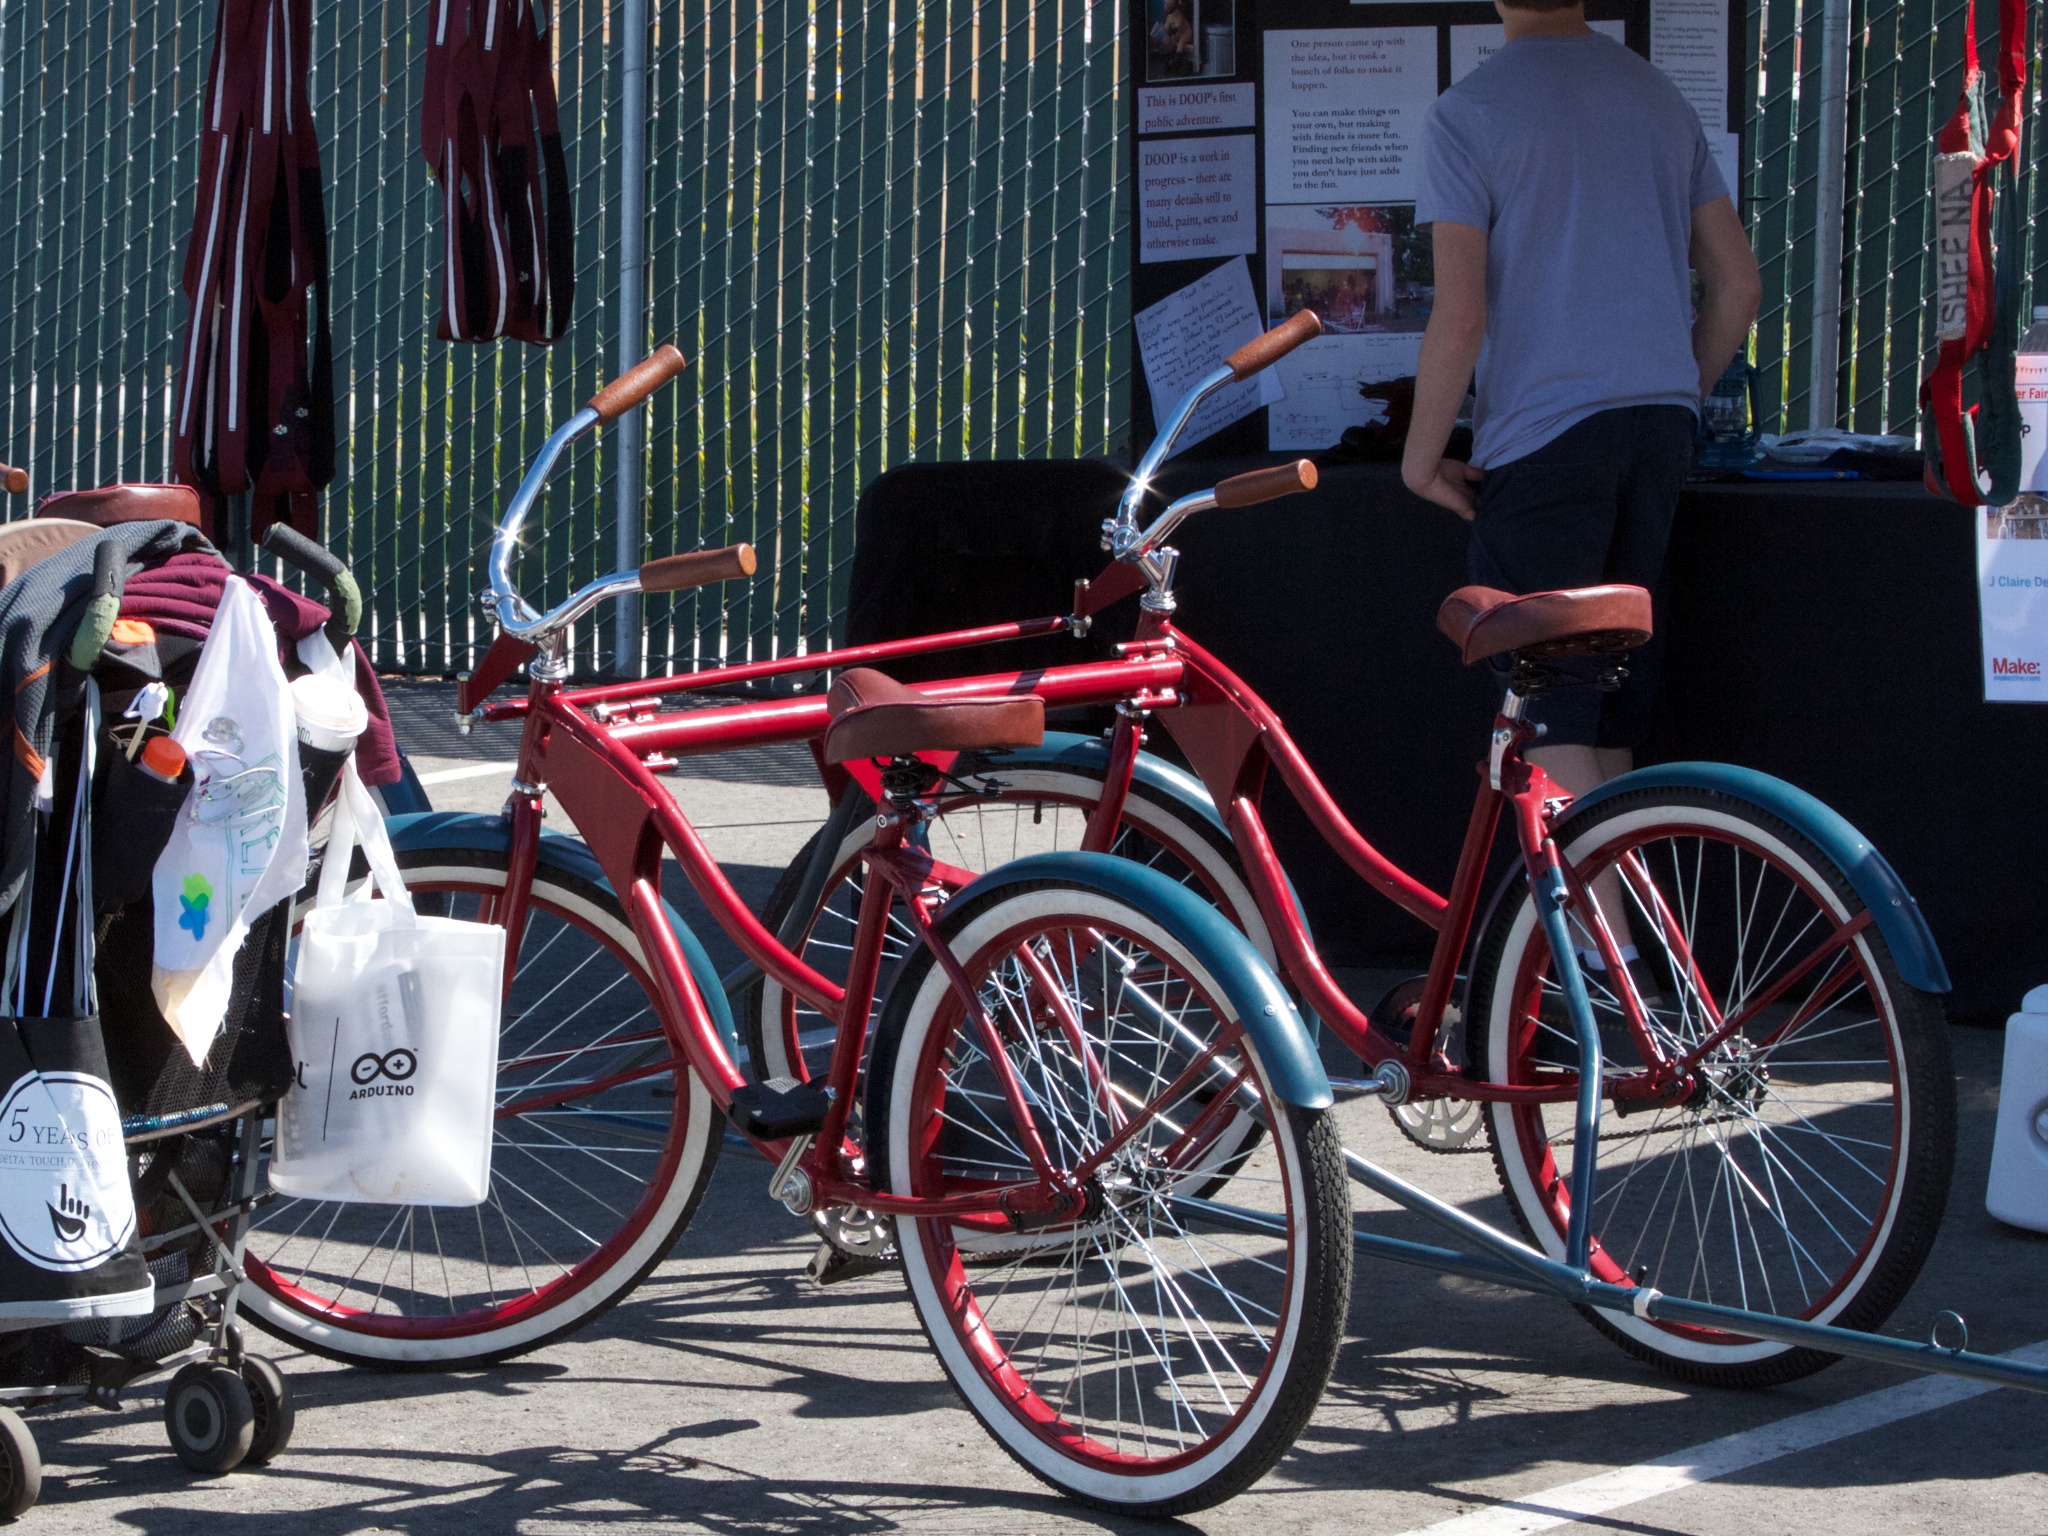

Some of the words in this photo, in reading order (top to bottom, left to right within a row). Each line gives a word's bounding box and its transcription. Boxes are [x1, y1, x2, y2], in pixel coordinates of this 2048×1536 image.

[1291, 40, 1310, 48] One
[1313, 41, 1343, 49] person
[1372, 40, 1384, 48] up
[1386, 37, 1405, 46] with
[1308, 54, 1330, 62] idea,
[1359, 52, 1378, 60] took
[1291, 67, 1319, 76] bunch
[1334, 66, 1355, 74] folks
[1292, 82, 1327, 91] happen.
[1145, 95, 1166, 107] This
[1169, 95, 1176, 105] is
[1179, 92, 1216, 105] DOOP's
[1219, 91, 1236, 103] first
[1292, 109, 1310, 117] You
[1332, 108, 1355, 116] make
[1359, 108, 1386, 117] things
[1145, 115, 1173, 132] public
[1176, 115, 1222, 126] adventure.
[1292, 122, 1312, 131] your
[1339, 120, 1353, 128] but
[1356, 120, 1390, 128] making
[1293, 133, 1311, 141] with
[1314, 132, 1344, 141] friends
[1384, 131, 1400, 139] fun.
[1293, 145, 1328, 154] Finding
[1352, 144, 1381, 152] friends
[1385, 143, 1408, 151] when
[1145, 153, 1177, 166] DOOP
[1180, 154, 1187, 163] is
[1199, 152, 1219, 162] work
[1221, 151, 1229, 161] in
[1293, 158, 1308, 168] you
[1336, 156, 1355, 166] help
[1358, 155, 1376, 163] with
[1293, 170, 1308, 179] you
[1312, 168, 1334, 177] don't
[1337, 168, 1357, 176] have
[1361, 167, 1376, 177] just
[1145, 175, 1185, 191] progress
[1196, 173, 1216, 184] there
[1219, 173, 1232, 182] are
[1321, 180, 1338, 188] fun.
[1146, 195, 1172, 210] many
[1174, 193, 1203, 206] details
[1206, 192, 1220, 204] still
[1223, 194, 1231, 203] to
[1147, 217, 1173, 230] build,
[1176, 216, 1201, 230] paint,
[1204, 217, 1218, 225] sew
[1222, 212, 1238, 222] and
[1147, 237, 1189, 250] otherwise
[1192, 235, 1218, 246] make.
[1990, 577, 1995, 587] J
[1999, 576, 2031, 587] Claire
[1993, 658, 2041, 674] Make:
[349, 1085, 414, 1100] ARDUINO
[9, 1107, 29, 1142] 5
[33, 1126, 88, 1150] YEAS
